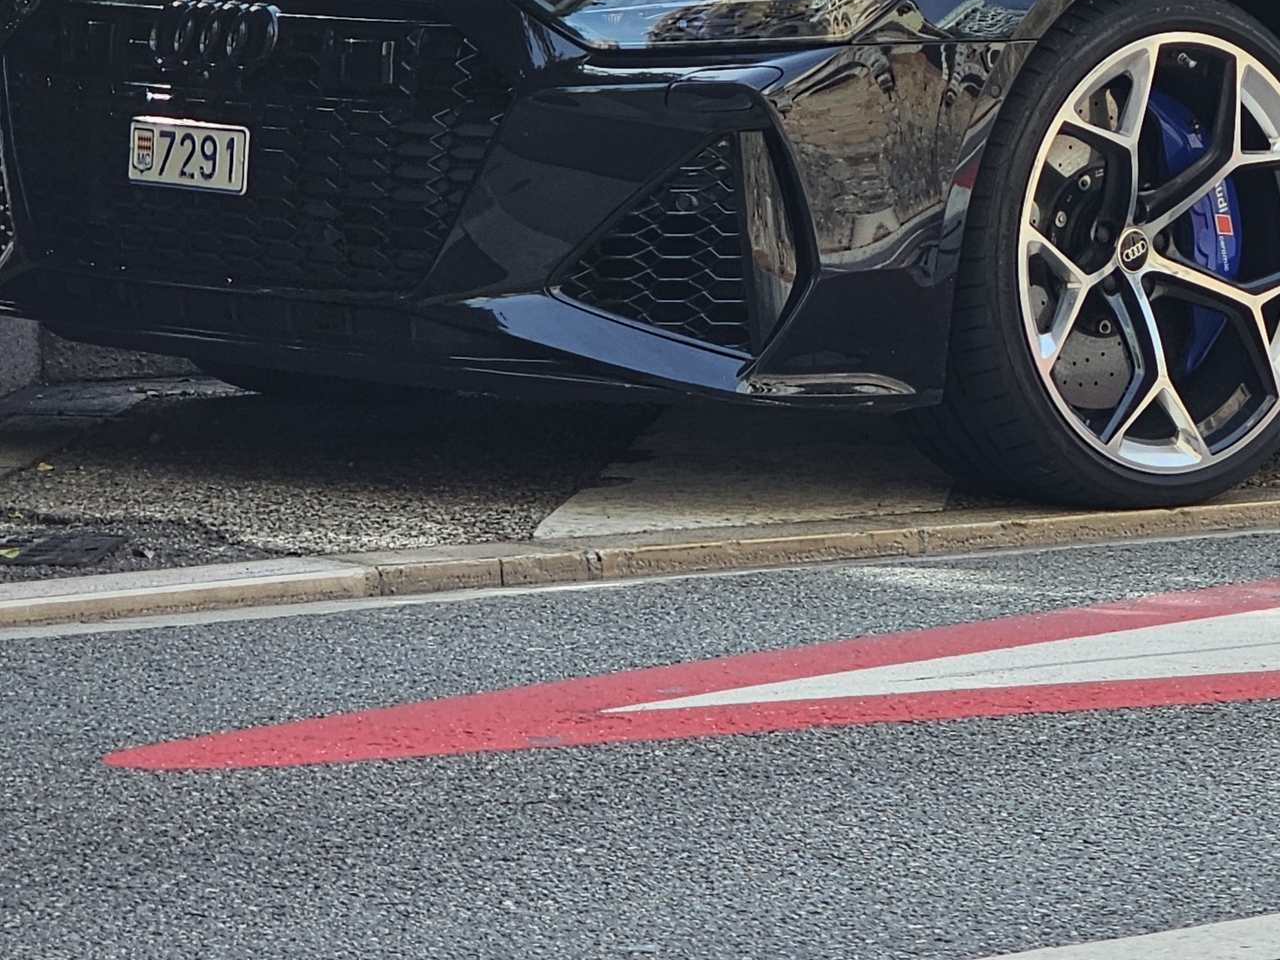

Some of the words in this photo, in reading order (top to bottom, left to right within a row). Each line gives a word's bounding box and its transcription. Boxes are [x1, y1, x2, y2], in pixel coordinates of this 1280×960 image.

[137, 152, 151, 166] MC
[158, 129, 236, 184] 7291
[1214, 182, 1229, 214] udi
[1219, 235, 1230, 272] ceramic
